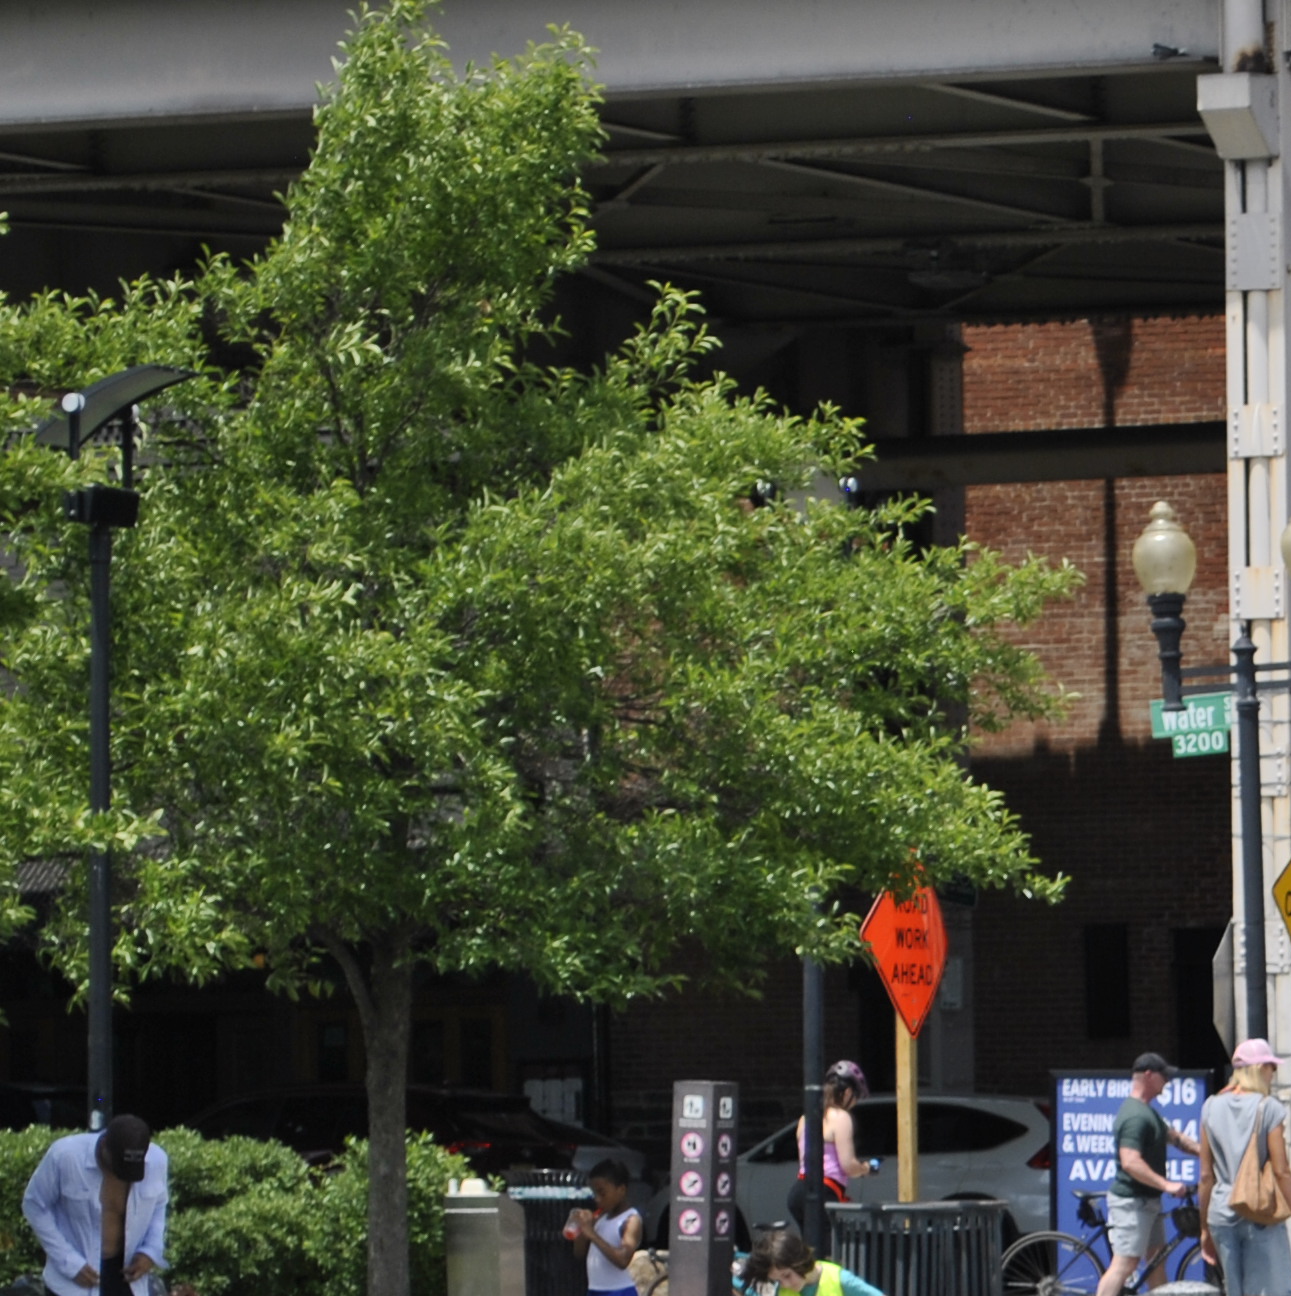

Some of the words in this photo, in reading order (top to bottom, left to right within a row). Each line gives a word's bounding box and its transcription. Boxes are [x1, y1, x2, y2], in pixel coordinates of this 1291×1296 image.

[1161, 704, 1216, 732] Water
[1174, 731, 1224, 754] 3200
[895, 927, 928, 949] WORK
[891, 963, 933, 985] AHEAD
[1062, 1078, 1105, 1098] EARLY
[1107, 1079, 1133, 1098] BIR
[1157, 1078, 1198, 1106] $16
[1063, 1112, 1114, 1132] EVENIN
[1062, 1135, 1075, 1153] &
[1076, 1135, 1116, 1154] WEEK
